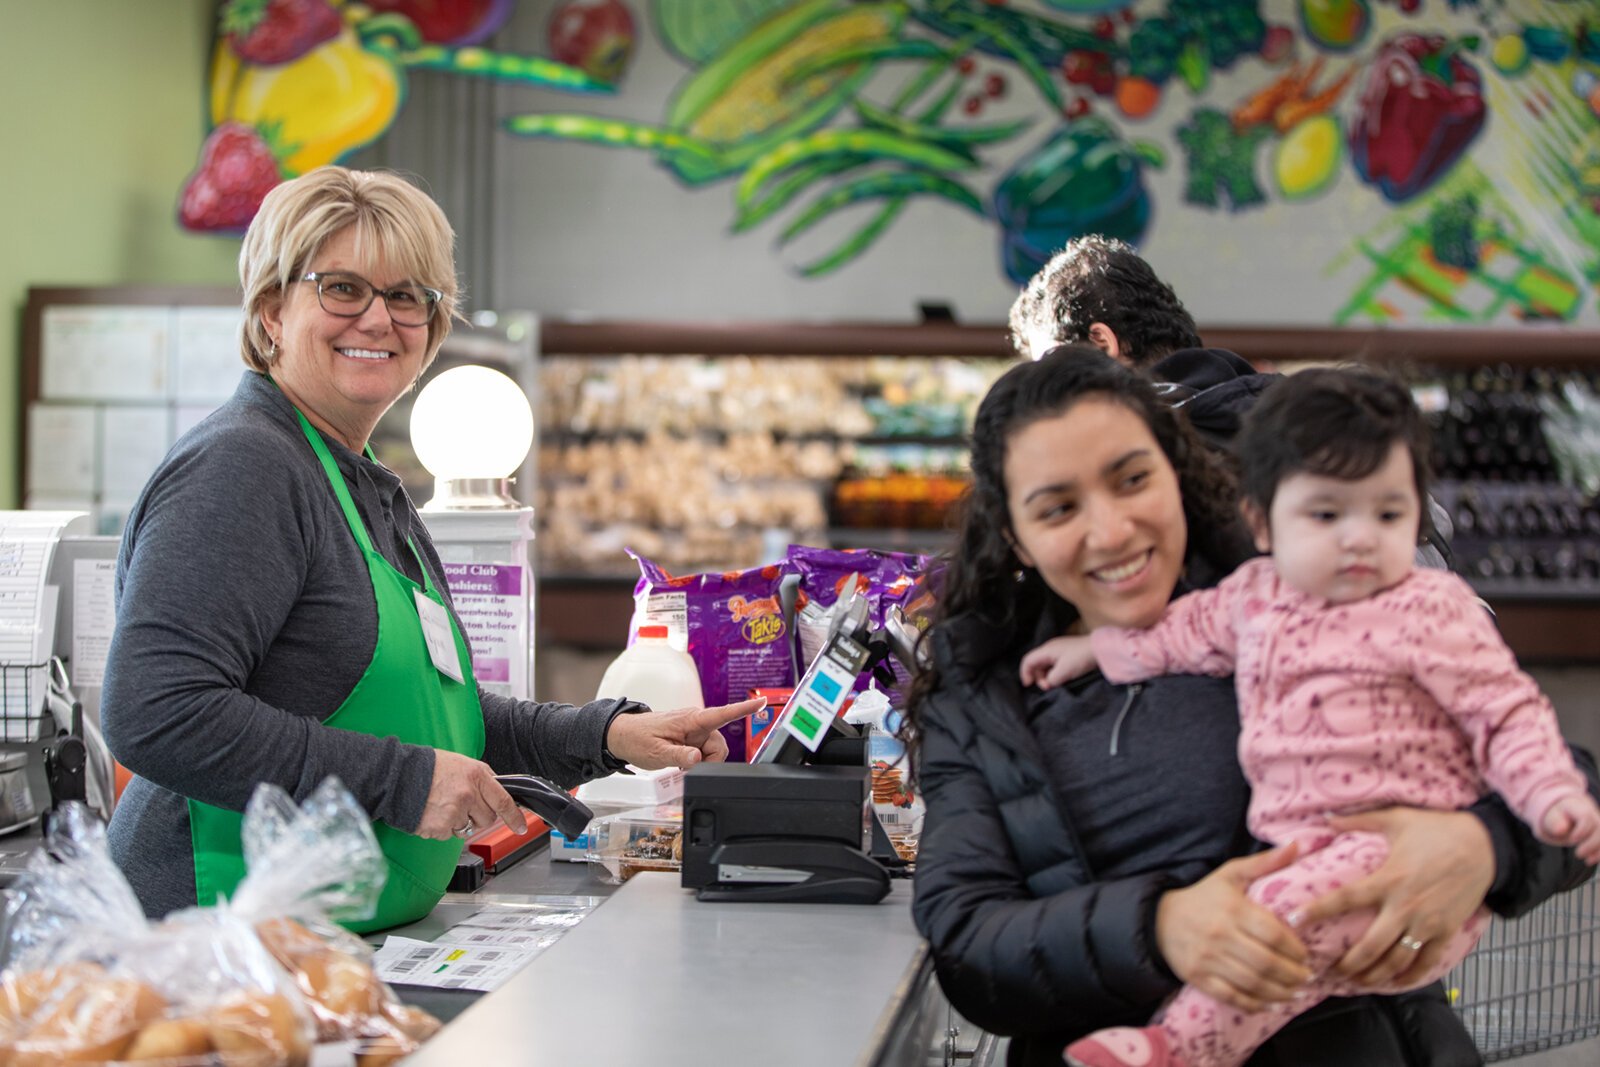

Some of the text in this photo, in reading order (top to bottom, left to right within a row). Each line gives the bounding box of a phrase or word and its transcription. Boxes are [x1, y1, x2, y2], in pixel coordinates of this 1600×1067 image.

[445, 565, 498, 577] ood Club
[450, 580, 492, 592] ashiers:
[491, 596, 506, 604] the
[486, 622, 517, 630] before
[748, 614, 782, 643] Takis
[470, 635, 507, 644] saction.
